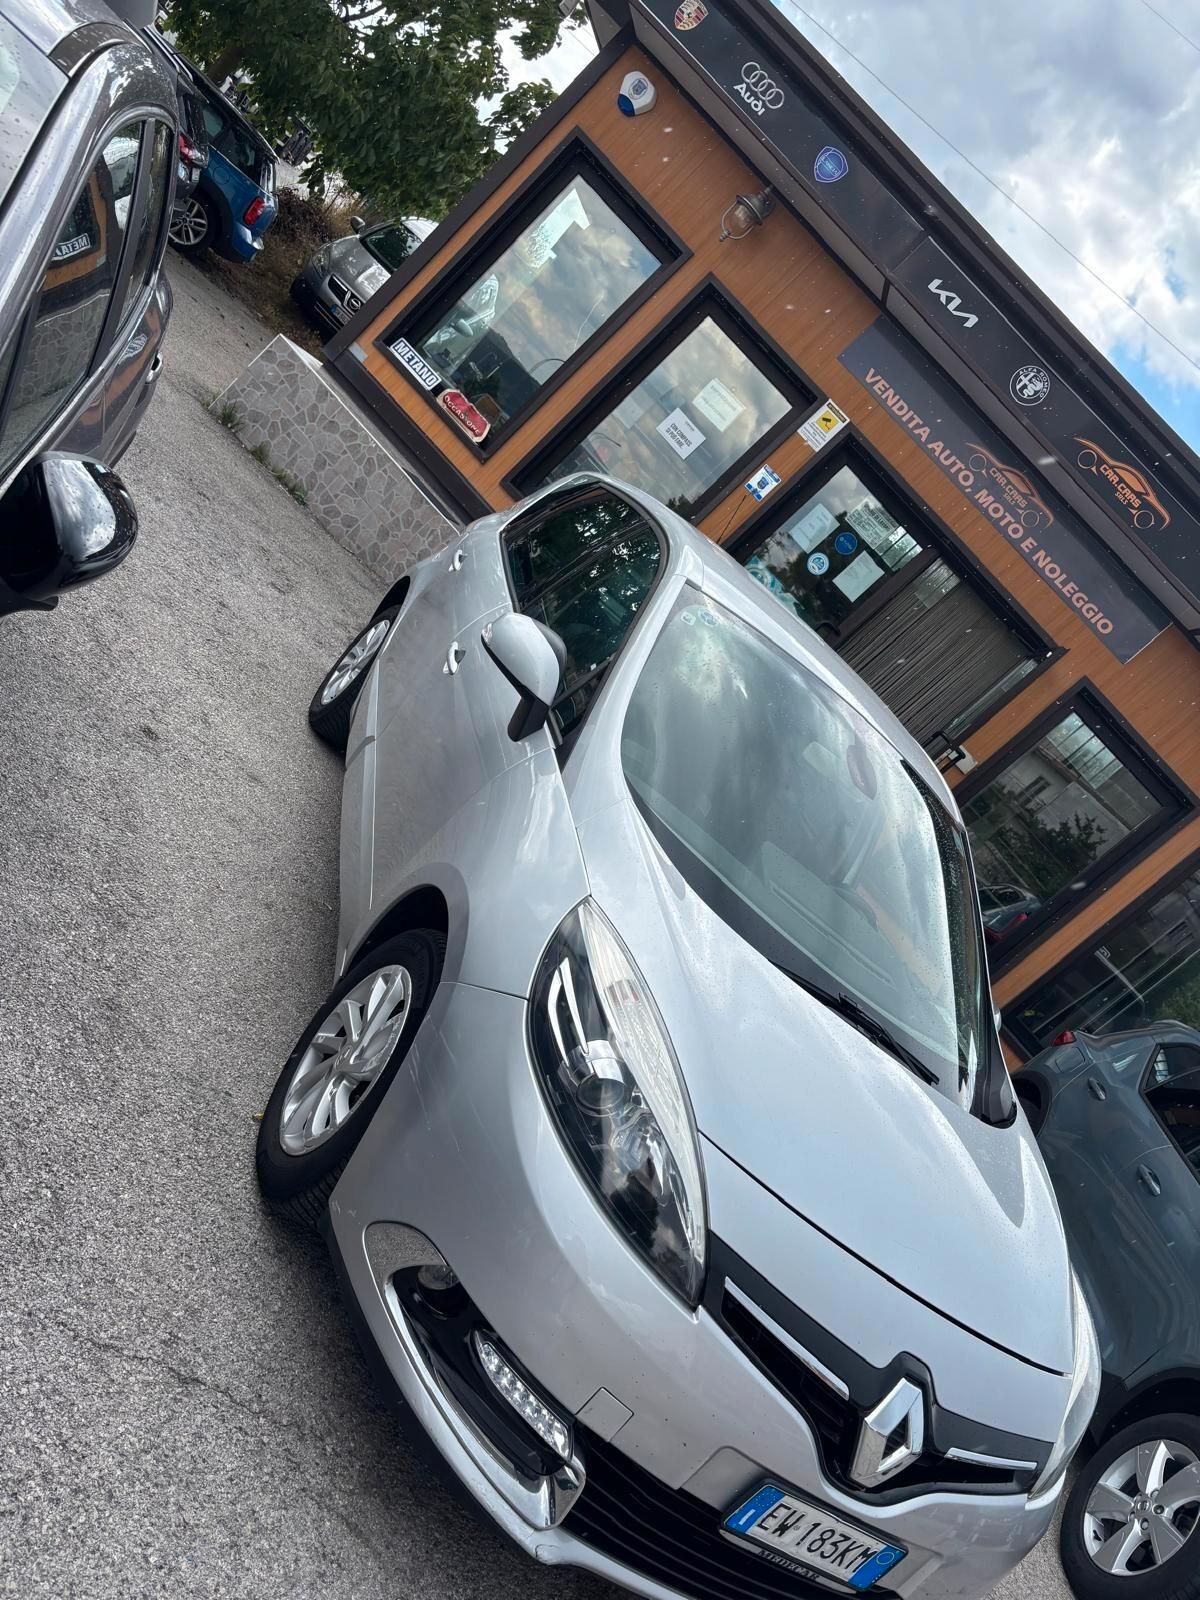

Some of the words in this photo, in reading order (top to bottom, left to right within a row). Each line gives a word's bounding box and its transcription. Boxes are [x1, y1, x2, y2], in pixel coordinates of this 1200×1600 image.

[733, 82, 765, 116] Audi
[927, 278, 979, 328] KIA
[394, 341, 437, 386] METANO
[1019, 367, 1038, 376] ALFA
[1039, 371, 1049, 398] ROMEO
[444, 395, 480, 435] OCCASONE
[865, 367, 930, 442] VENDITA
[926, 441, 974, 493] AUTO,
[974, 488, 1024, 539] MOTO
[1020, 536, 1038, 553] E
[1031, 549, 1113, 634] NOLEGGIO
[989, 467, 1028, 508] CAR.CARS
[1100, 463, 1142, 508] CAR.CARS
[1114, 491, 1129, 505] SRLS
